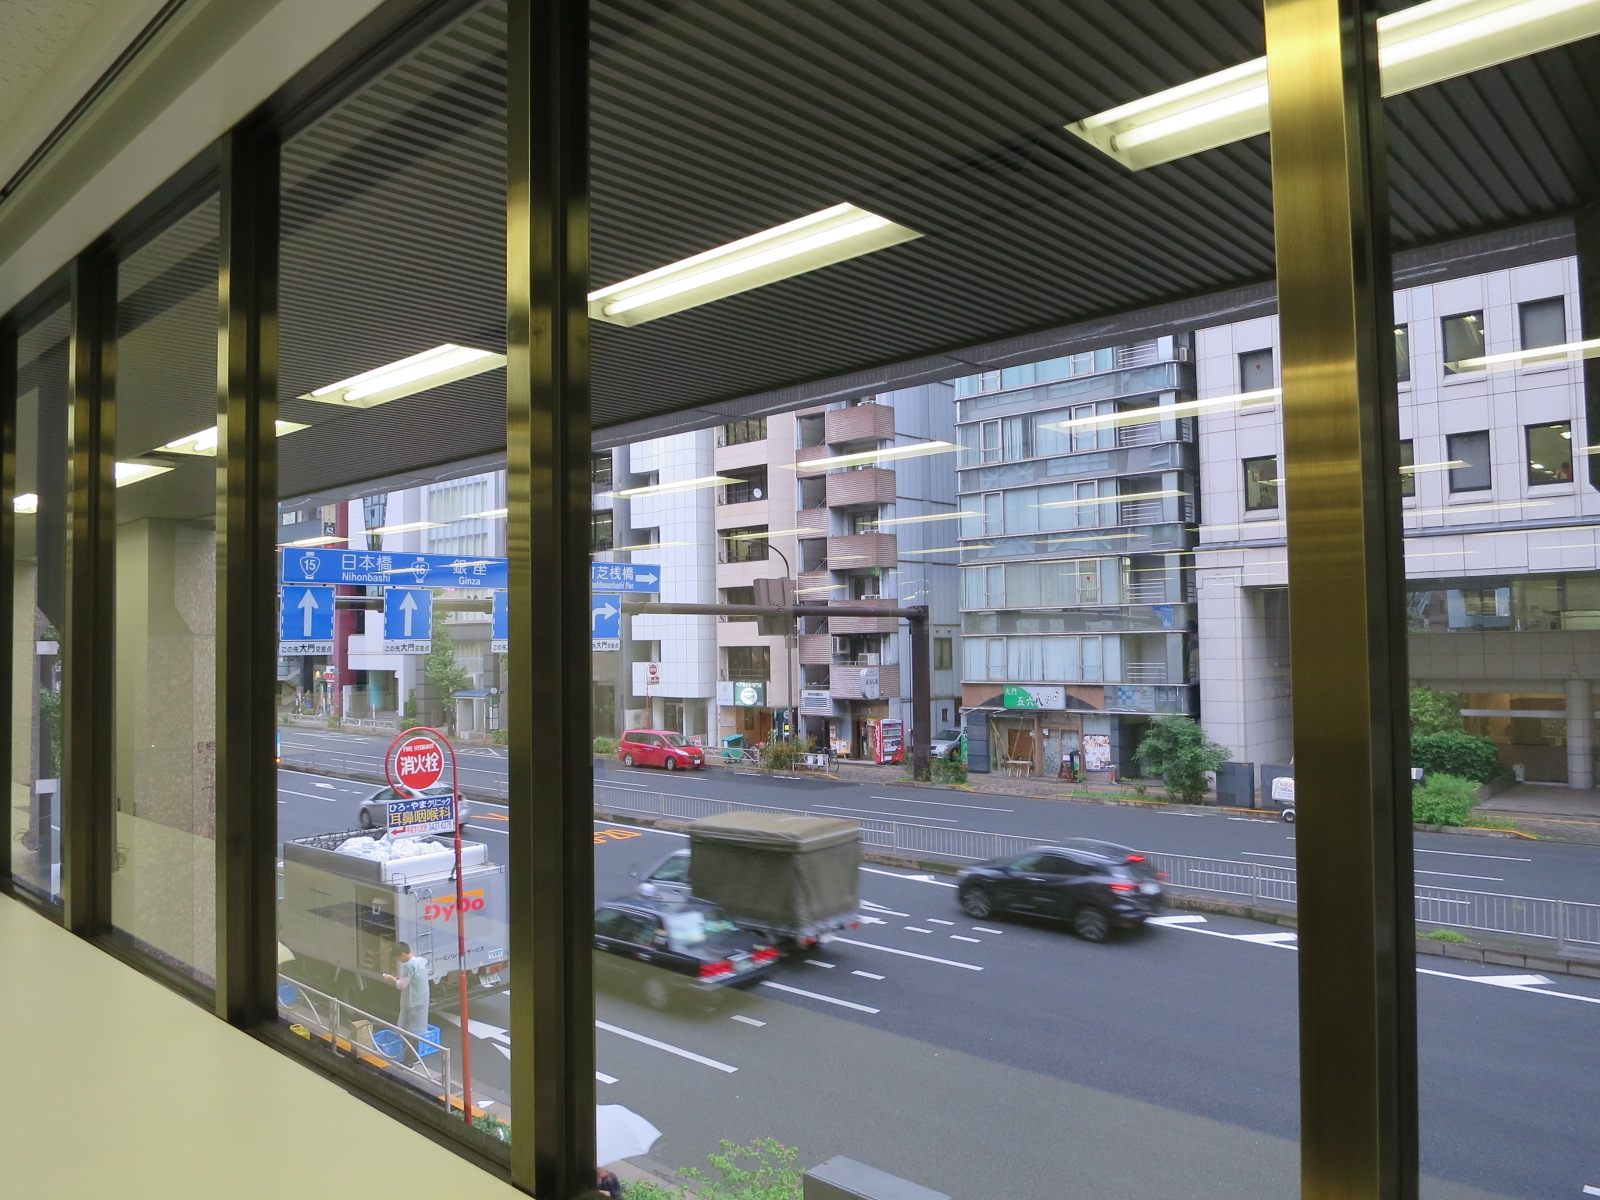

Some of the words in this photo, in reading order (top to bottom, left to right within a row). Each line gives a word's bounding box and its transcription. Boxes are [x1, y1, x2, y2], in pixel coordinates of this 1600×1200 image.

[304, 559, 316, 571] 15
[341, 554, 392, 571] 日本橋
[452, 558, 488, 576] 銀座
[415, 564, 426, 575] 15
[341, 571, 391, 583] Nihonbashi
[458, 576, 481, 586] Ginza
[1005, 687, 1018, 696] 大門
[402, 745, 413, 753] FIRE
[413, 743, 435, 751] HYDRANT
[400, 752, 440, 776] 消火栓
[389, 798, 451, 813] ひろ・やまクリニック
[389, 806, 452, 825] 耳鼻咽喉科
[424, 897, 485, 922] DyDo
